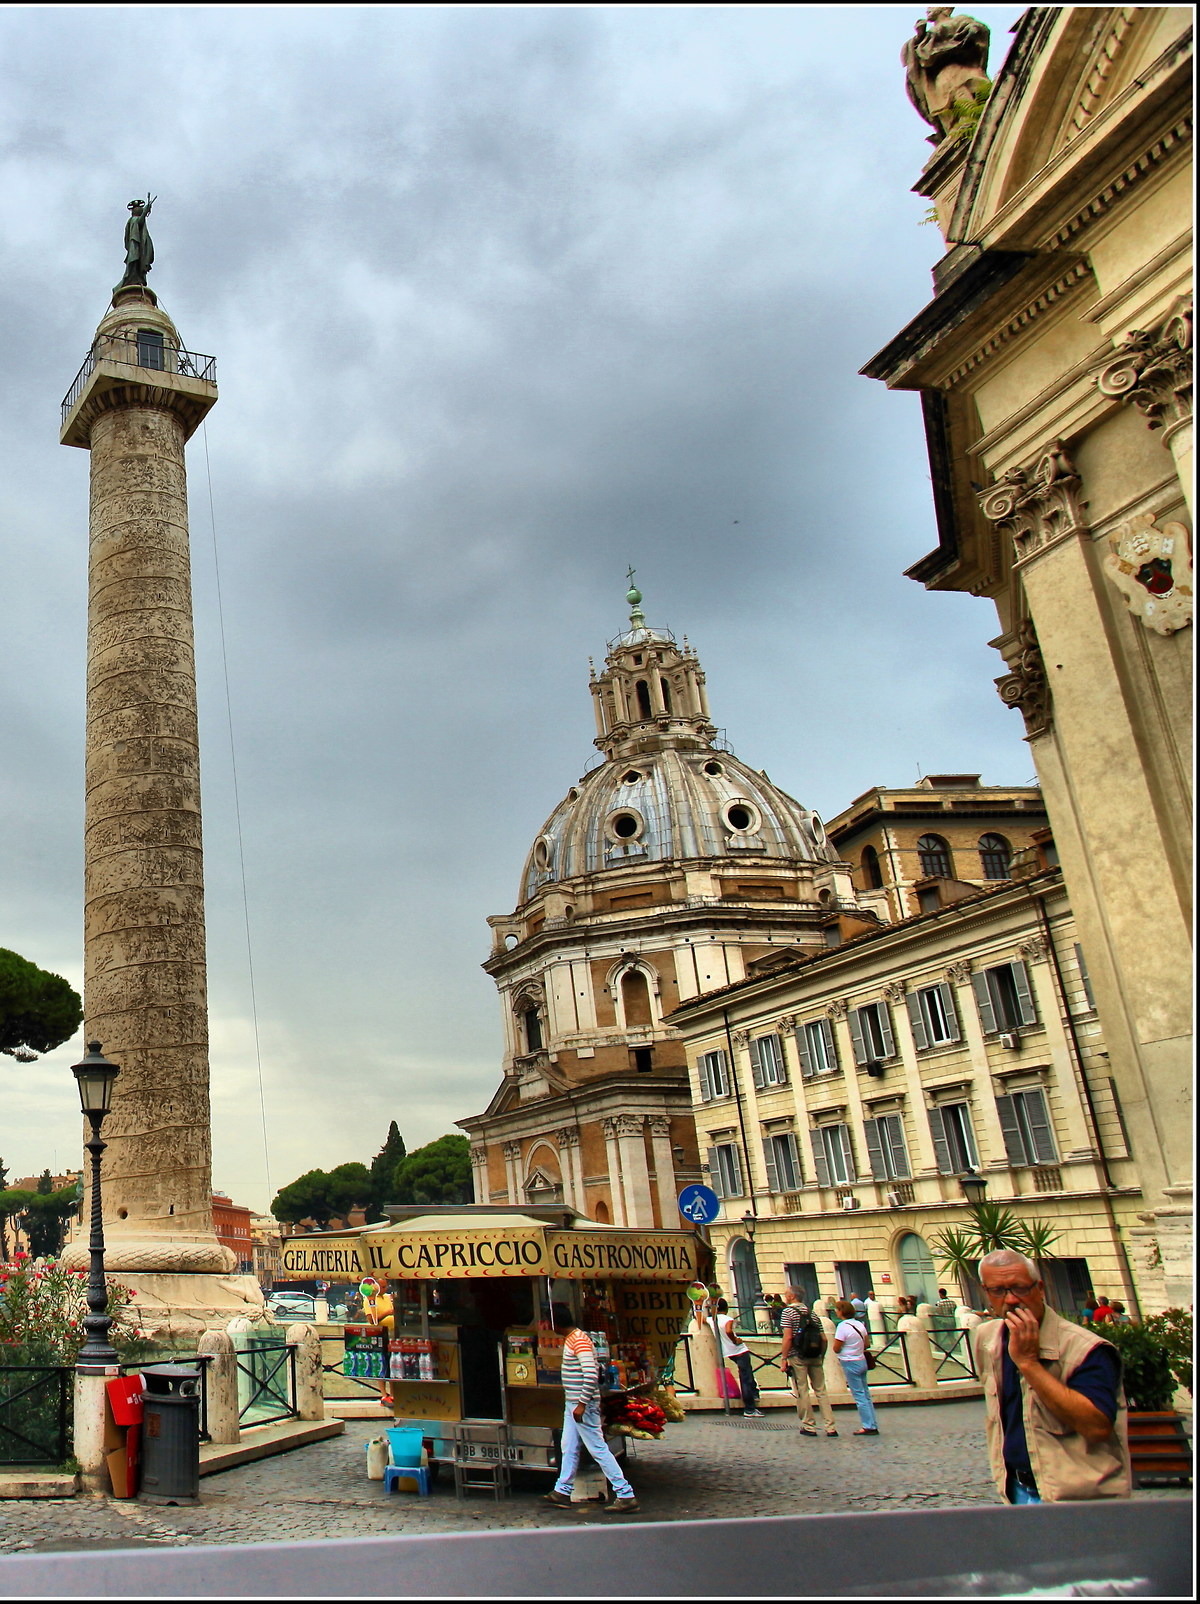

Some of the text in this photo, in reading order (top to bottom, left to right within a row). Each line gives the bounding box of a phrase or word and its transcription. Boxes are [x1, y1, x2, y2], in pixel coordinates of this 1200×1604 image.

[284, 1250, 363, 1273] GELATERIA
[369, 1240, 542, 1269] IL CAPRICCIO
[553, 1243, 693, 1270] GASTRONOMIA
[626, 1316, 652, 1335] ICE
[481, 1446, 500, 1458] 988
